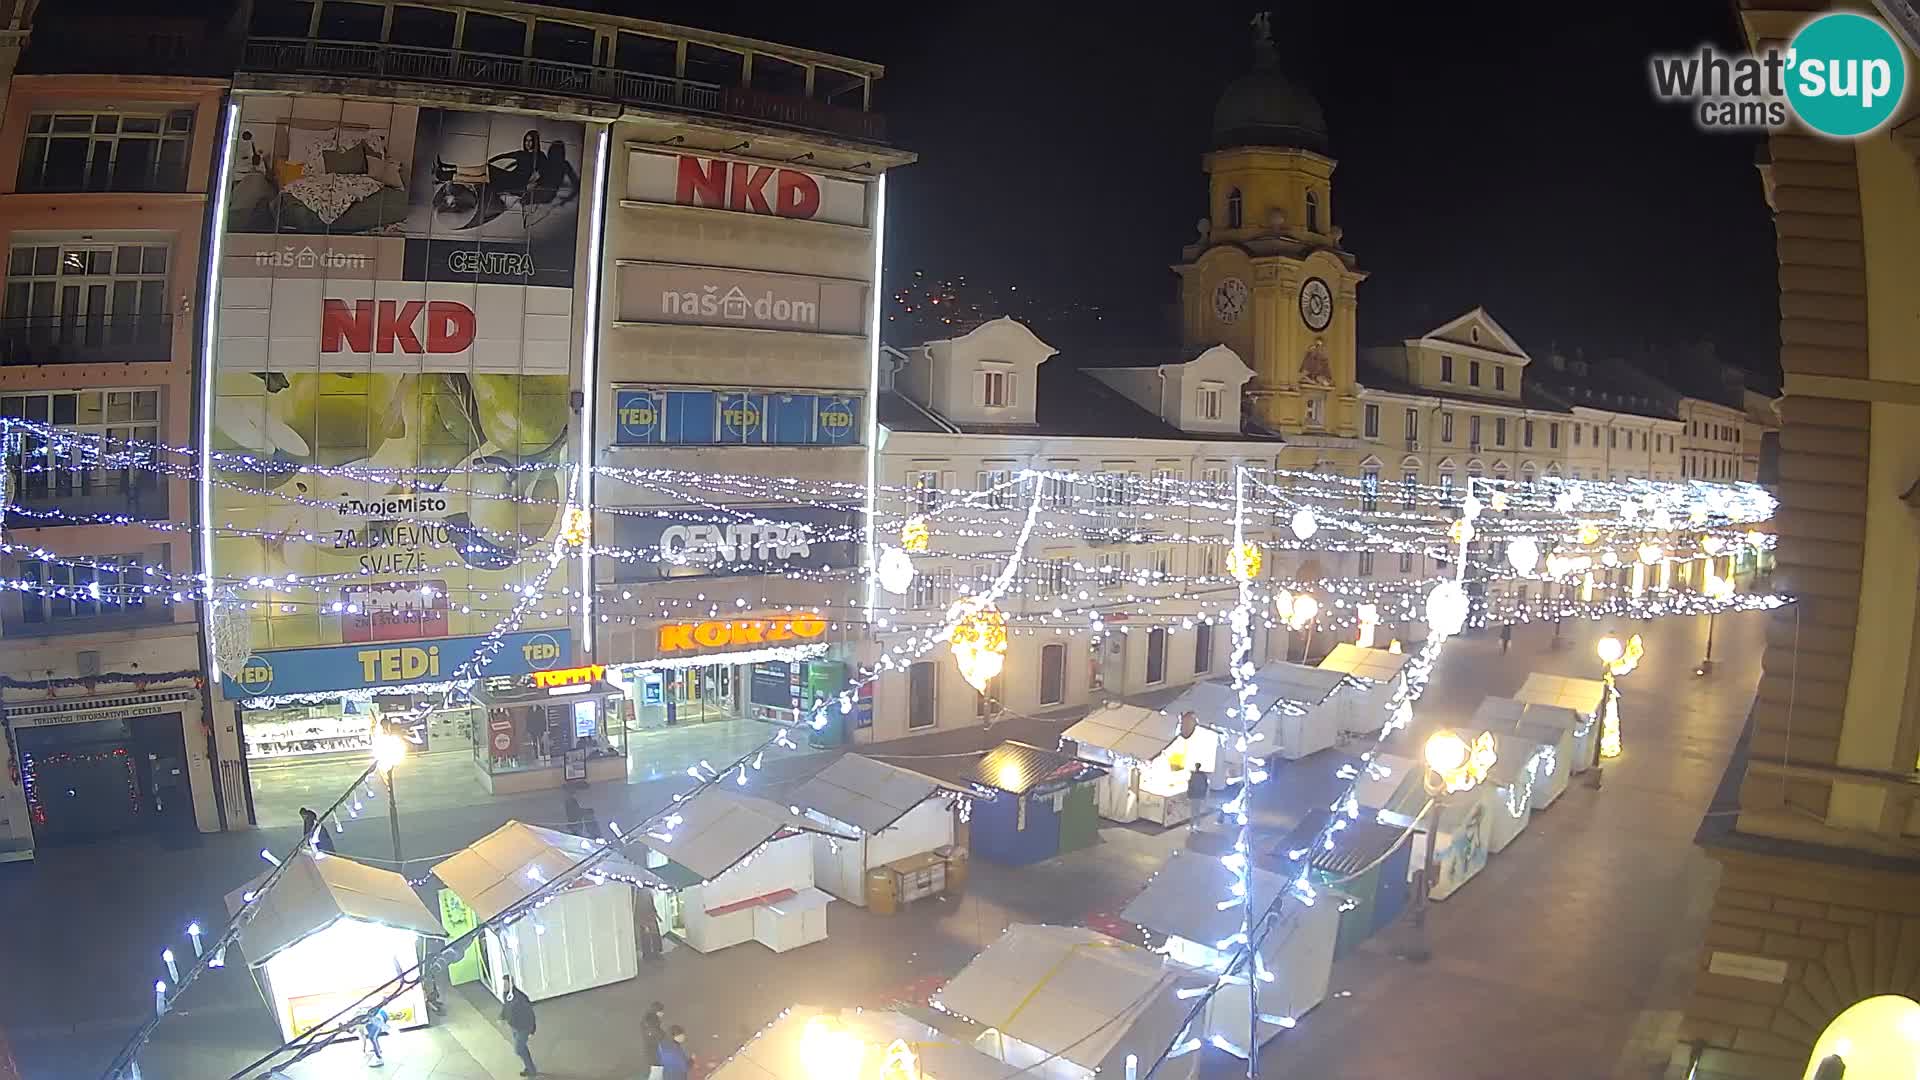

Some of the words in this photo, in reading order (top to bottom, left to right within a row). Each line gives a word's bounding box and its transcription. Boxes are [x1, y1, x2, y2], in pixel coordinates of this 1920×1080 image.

[674, 155, 820, 219] NKD
[255, 245, 296, 269] naš
[319, 245, 366, 269] dom
[448, 250, 535, 276] CENTRA
[661, 285, 719, 317] naš
[754, 290, 816, 324] dom
[320, 298, 477, 354] NKD
[618, 408, 658, 426] TEDi
[723, 409, 760, 426] TEDi
[820, 410, 853, 427] TEDi
[338, 497, 446, 517] #TvojeMisto
[333, 529, 358, 549] ZA
[368, 525, 449, 549] DNEVNO
[659, 523, 811, 563] CENTRA
[359, 547, 426, 575] SVJEŽE
[659, 612, 827, 652] KORZO
[358, 644, 440, 681] TEDi
[522, 644, 560, 660] TEDi
